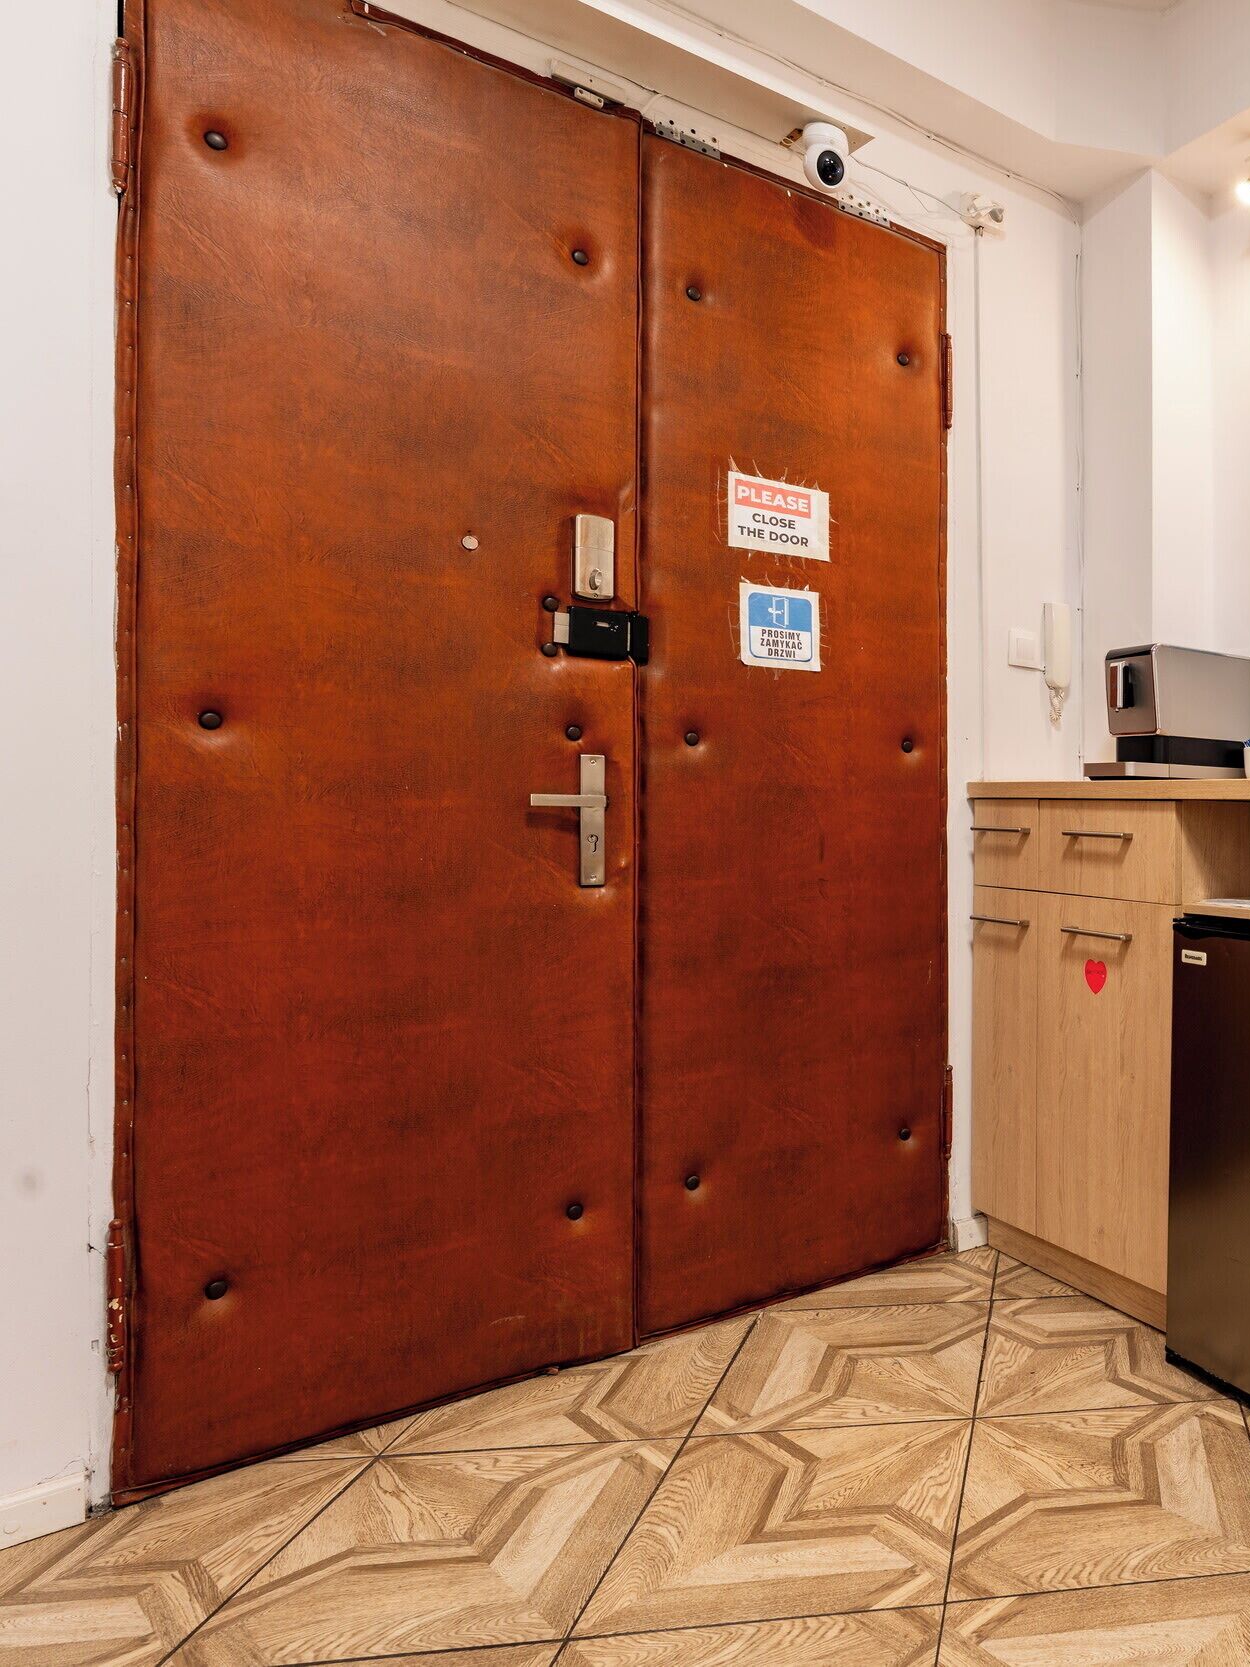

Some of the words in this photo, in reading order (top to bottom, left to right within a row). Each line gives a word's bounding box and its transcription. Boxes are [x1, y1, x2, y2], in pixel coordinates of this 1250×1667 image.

[737, 485, 809, 513] PLEASE
[752, 513, 796, 530] CLOSE
[737, 525, 765, 540] THE
[769, 531, 809, 548] DOOR
[761, 628, 801, 641] PROSIMY
[760, 638, 803, 651] ZAMYKAĆ
[767, 648, 796, 659] DRZWI
